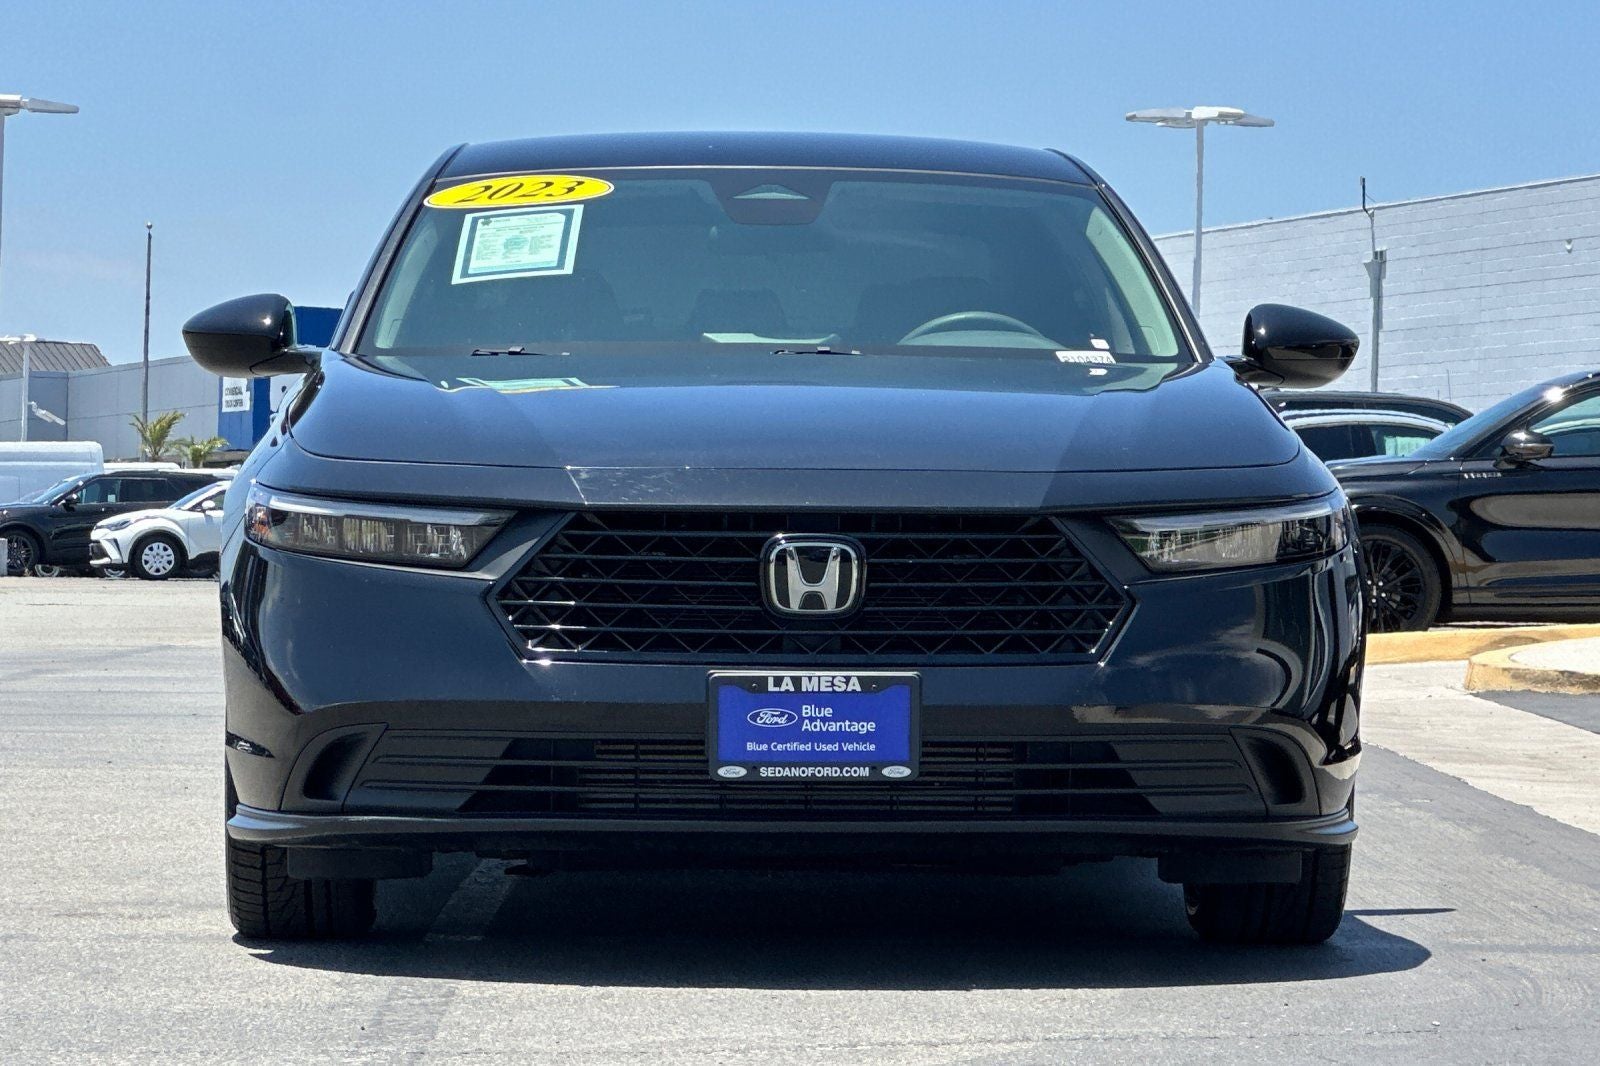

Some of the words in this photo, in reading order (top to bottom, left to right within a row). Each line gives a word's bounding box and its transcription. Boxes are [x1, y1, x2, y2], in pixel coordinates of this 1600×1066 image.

[454, 181, 586, 203] 2023
[767, 676, 795, 692] LA
[801, 676, 862, 692] MESA
[802, 704, 833, 717] Blue
[801, 719, 876, 734] Advantage
[746, 742, 768, 751] Blue
[770, 742, 812, 751] Certified
[814, 742, 839, 751] Used
[841, 742, 876, 751] Vehicle
[759, 766, 870, 777] SEDANOFORD.COM
